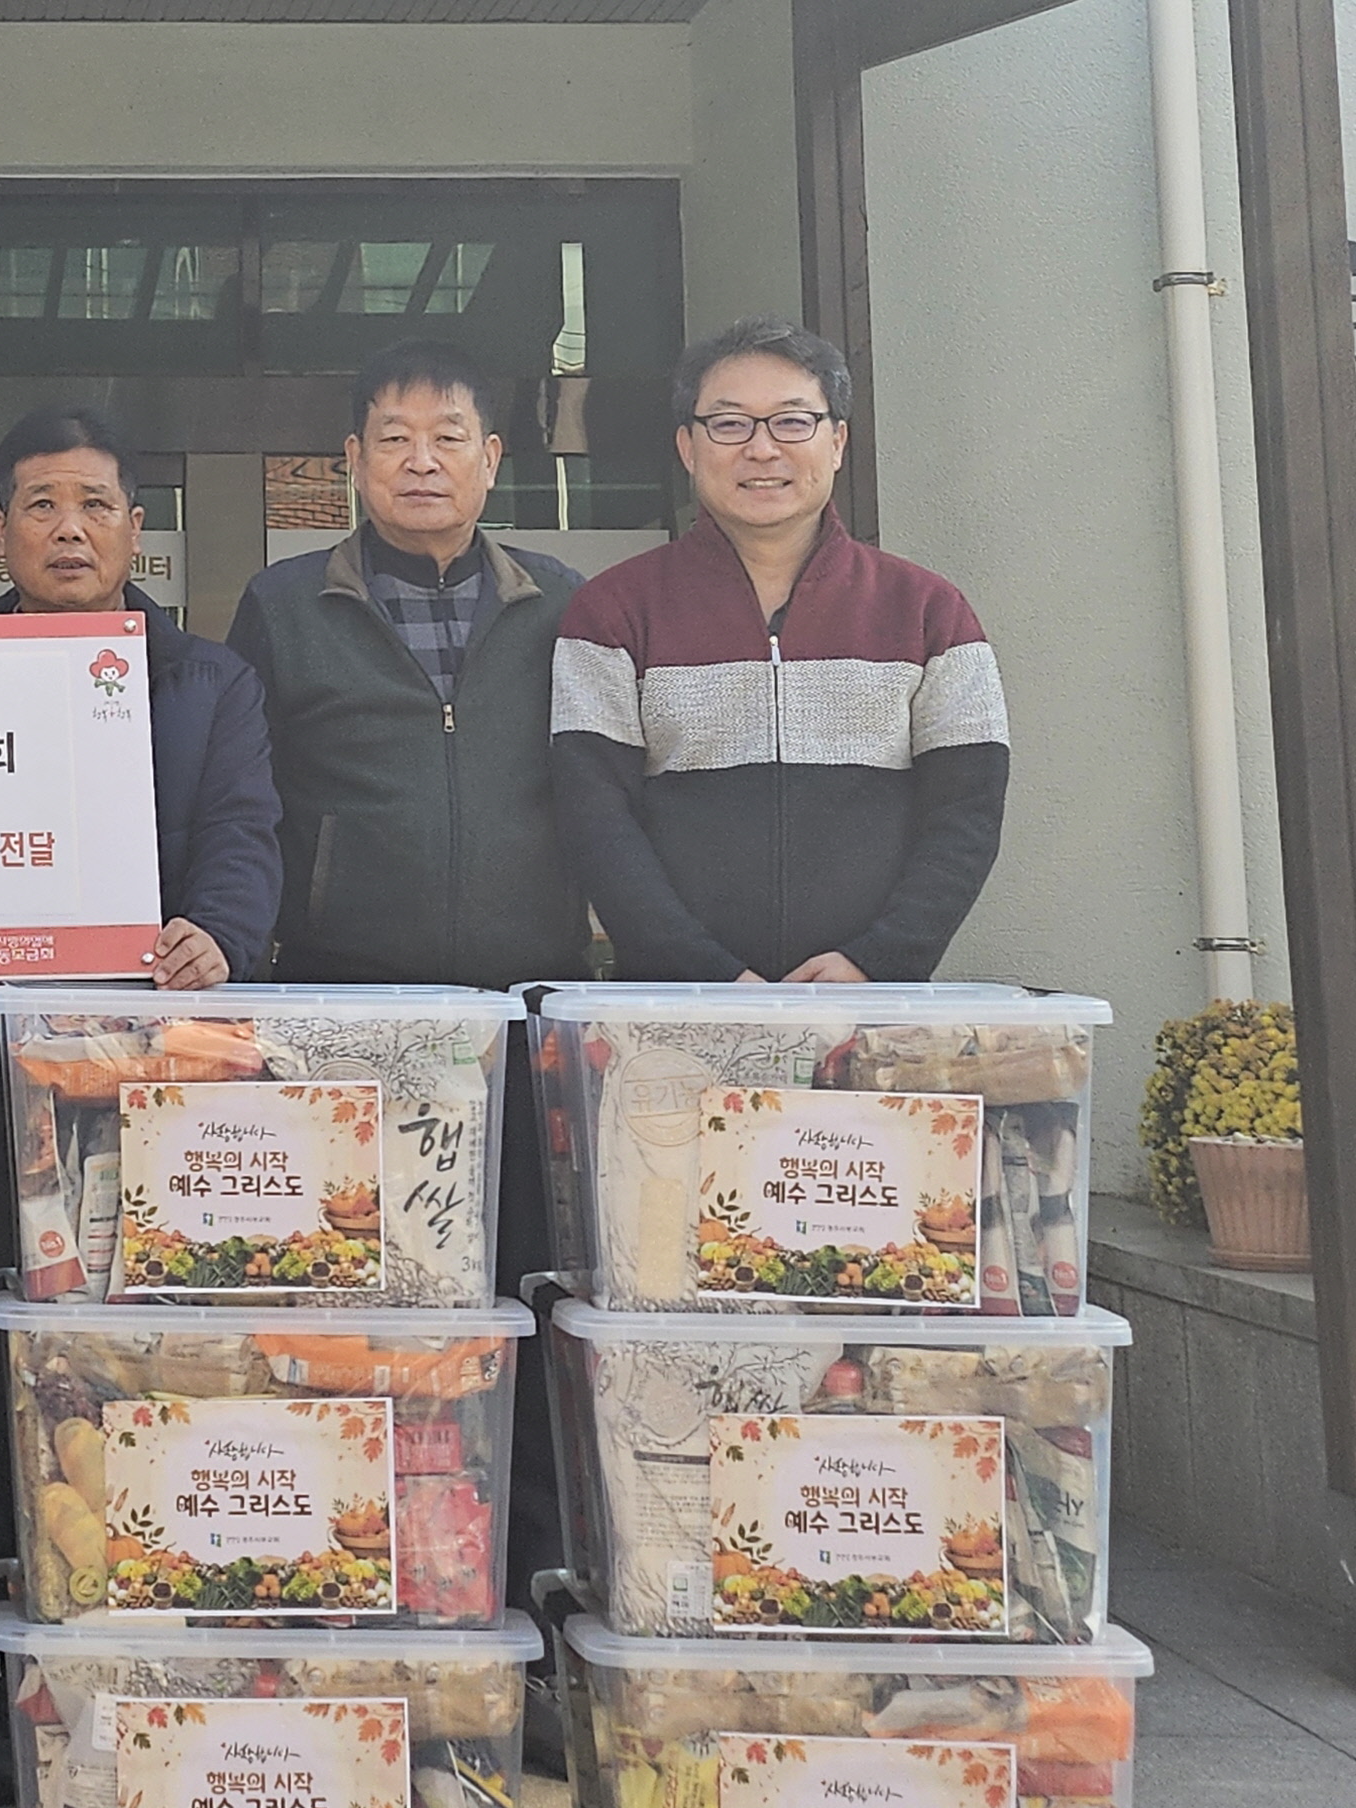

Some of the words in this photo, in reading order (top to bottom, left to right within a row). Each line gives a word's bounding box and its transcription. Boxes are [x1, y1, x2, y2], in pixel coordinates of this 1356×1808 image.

[0, 832, 55, 868] 전달
[184, 1150, 242, 1173] 행복의
[250, 1151, 288, 1173] 시작
[779, 1156, 838, 1181] 행복의
[846, 1160, 885, 1183] 시작
[169, 1174, 212, 1197] 예수
[220, 1174, 303, 1198] 그리스도
[763, 1180, 806, 1205] 예수
[815, 1182, 899, 1209] 그리스도
[191, 1469, 249, 1492] 행복의
[258, 1469, 297, 1491] 시작
[176, 1493, 219, 1517] 예수
[227, 1493, 312, 1517] 그리스도
[800, 1485, 860, 1509] 행복의
[868, 1487, 908, 1509] 시작
[785, 1509, 829, 1534] 예수
[837, 1510, 923, 1536] 그리스도
[206, 1772, 266, 1795] 행복의
[274, 1772, 314, 1795] 시작
